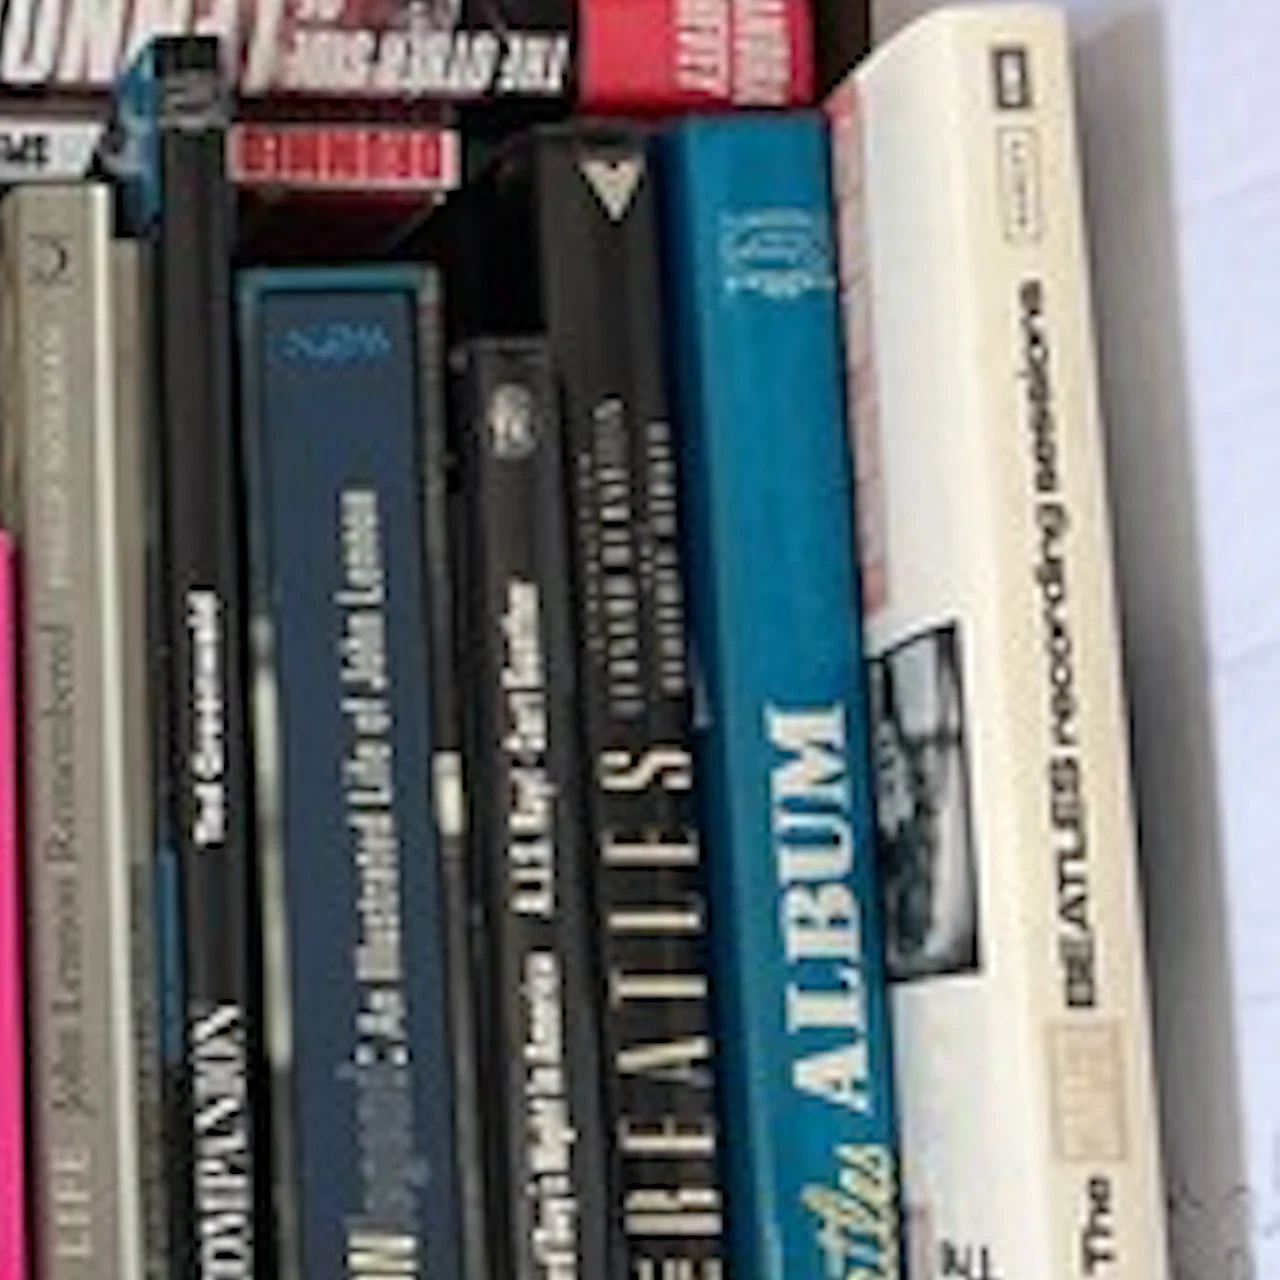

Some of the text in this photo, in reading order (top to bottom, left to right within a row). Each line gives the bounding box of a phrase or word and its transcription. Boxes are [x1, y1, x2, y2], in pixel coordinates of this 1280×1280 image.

[500, 35, 571, 99] THE
[336, 488, 383, 606] Lennon
[340, 614, 388, 690] John
[184, 592, 226, 845] Ted Greenwald
[343, 695, 388, 730] of
[346, 737, 392, 805] Life
[1011, 280, 1118, 1276] The BEATLES recording sessions
[38, 622, 85, 1116] John Lennon Remembered
[349, 815, 404, 986] Illustrated
[764, 703, 871, 1114] ALBUM
[356, 991, 404, 1036] An
[519, 953, 561, 1062] America
[597, 746, 724, 1236] BEATLES
[526, 1097, 574, 1169] Night
[52, 1147, 92, 1261] LIFE
